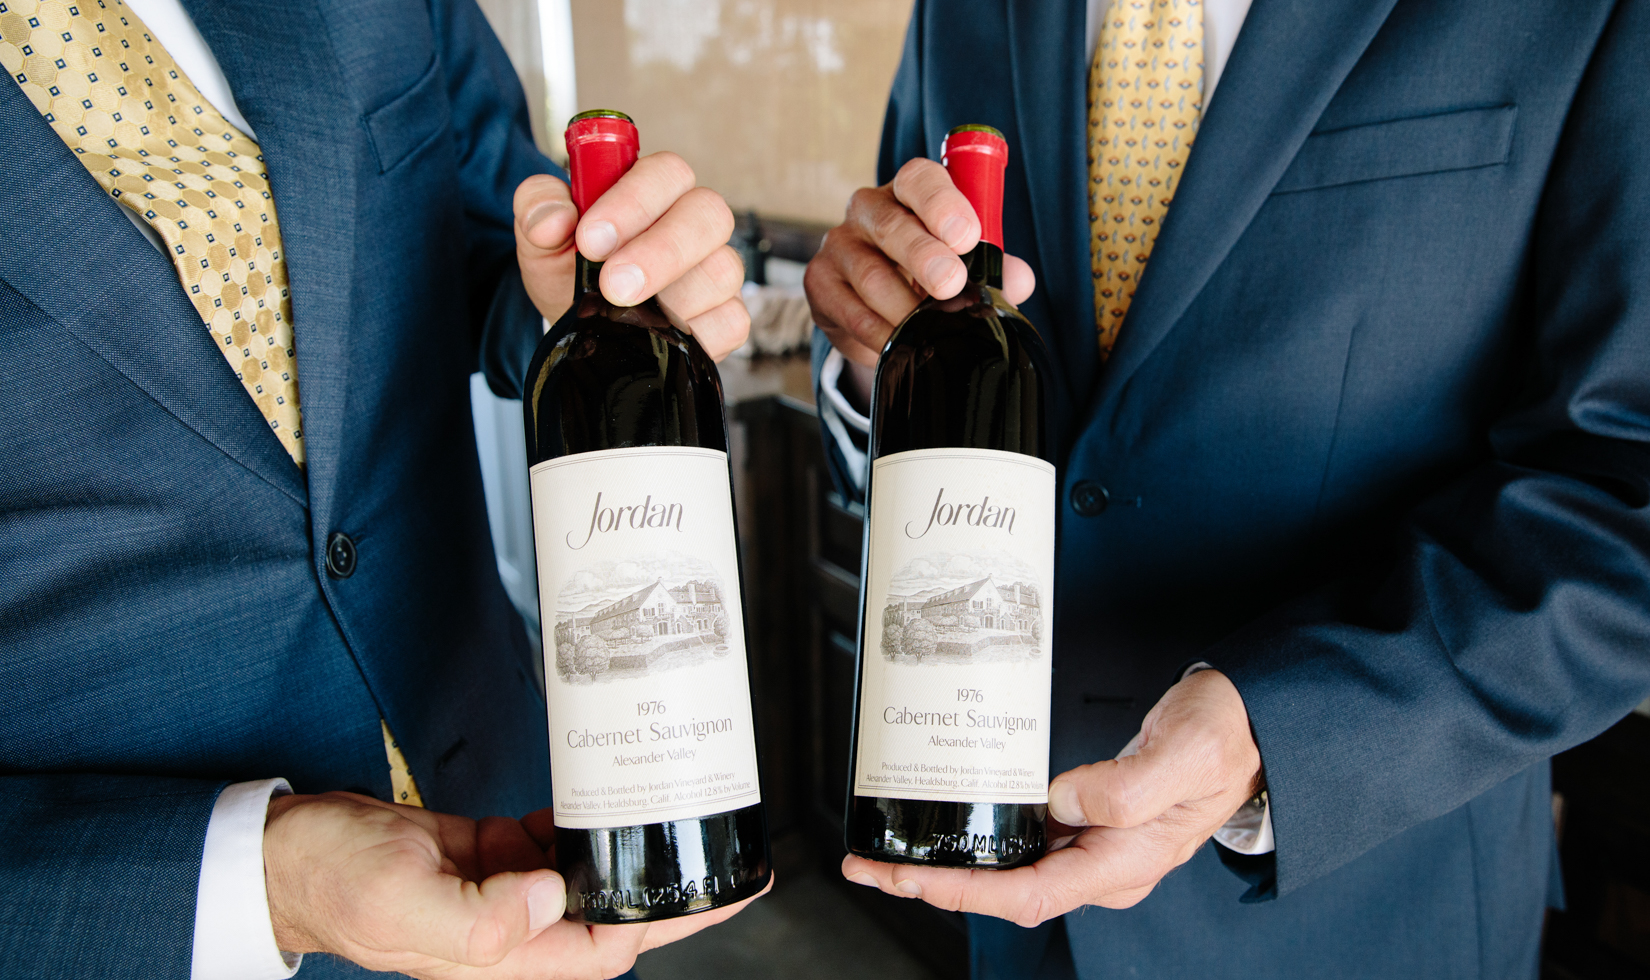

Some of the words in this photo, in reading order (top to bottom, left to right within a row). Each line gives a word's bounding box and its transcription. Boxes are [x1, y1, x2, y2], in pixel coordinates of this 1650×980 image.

[566, 491, 684, 550] Jordan
[905, 488, 1016, 539] Jordan
[957, 689, 984, 703] 1976
[637, 700, 666, 717] 1976
[883, 706, 959, 727] Cabernet
[966, 709, 1037, 735] Sauvignon
[567, 728, 642, 749] Cabernet
[650, 717, 733, 742] Sauvignon
[928, 735, 978, 749] Alexander
[980, 738, 1006, 752] Valley
[612, 750, 665, 767] Alexander
[667, 748, 697, 763] Valley
[882, 762, 912, 772] Produced
[914, 763, 919, 772] &
[921, 764, 947, 773] Bottled
[950, 765, 958, 776] by
[960, 766, 983, 775] Jordan
[984, 767, 1012, 778] Vineyard
[571, 787, 599, 797] Produced
[600, 787, 606, 795] &
[608, 784, 635, 795] Bottled
[637, 783, 646, 794] by
[649, 781, 673, 792] Jordan
[674, 775, 706, 787] Vineyard
[708, 774, 713, 782] &
[713, 772, 735, 781] Winery
[674, 788, 702, 801] Alcohol
[705, 786, 723, 797] 12.8%
[724, 784, 731, 793] by
[731, 781, 750, 791] Volume
[982, 779, 1007, 789] Alcohol
